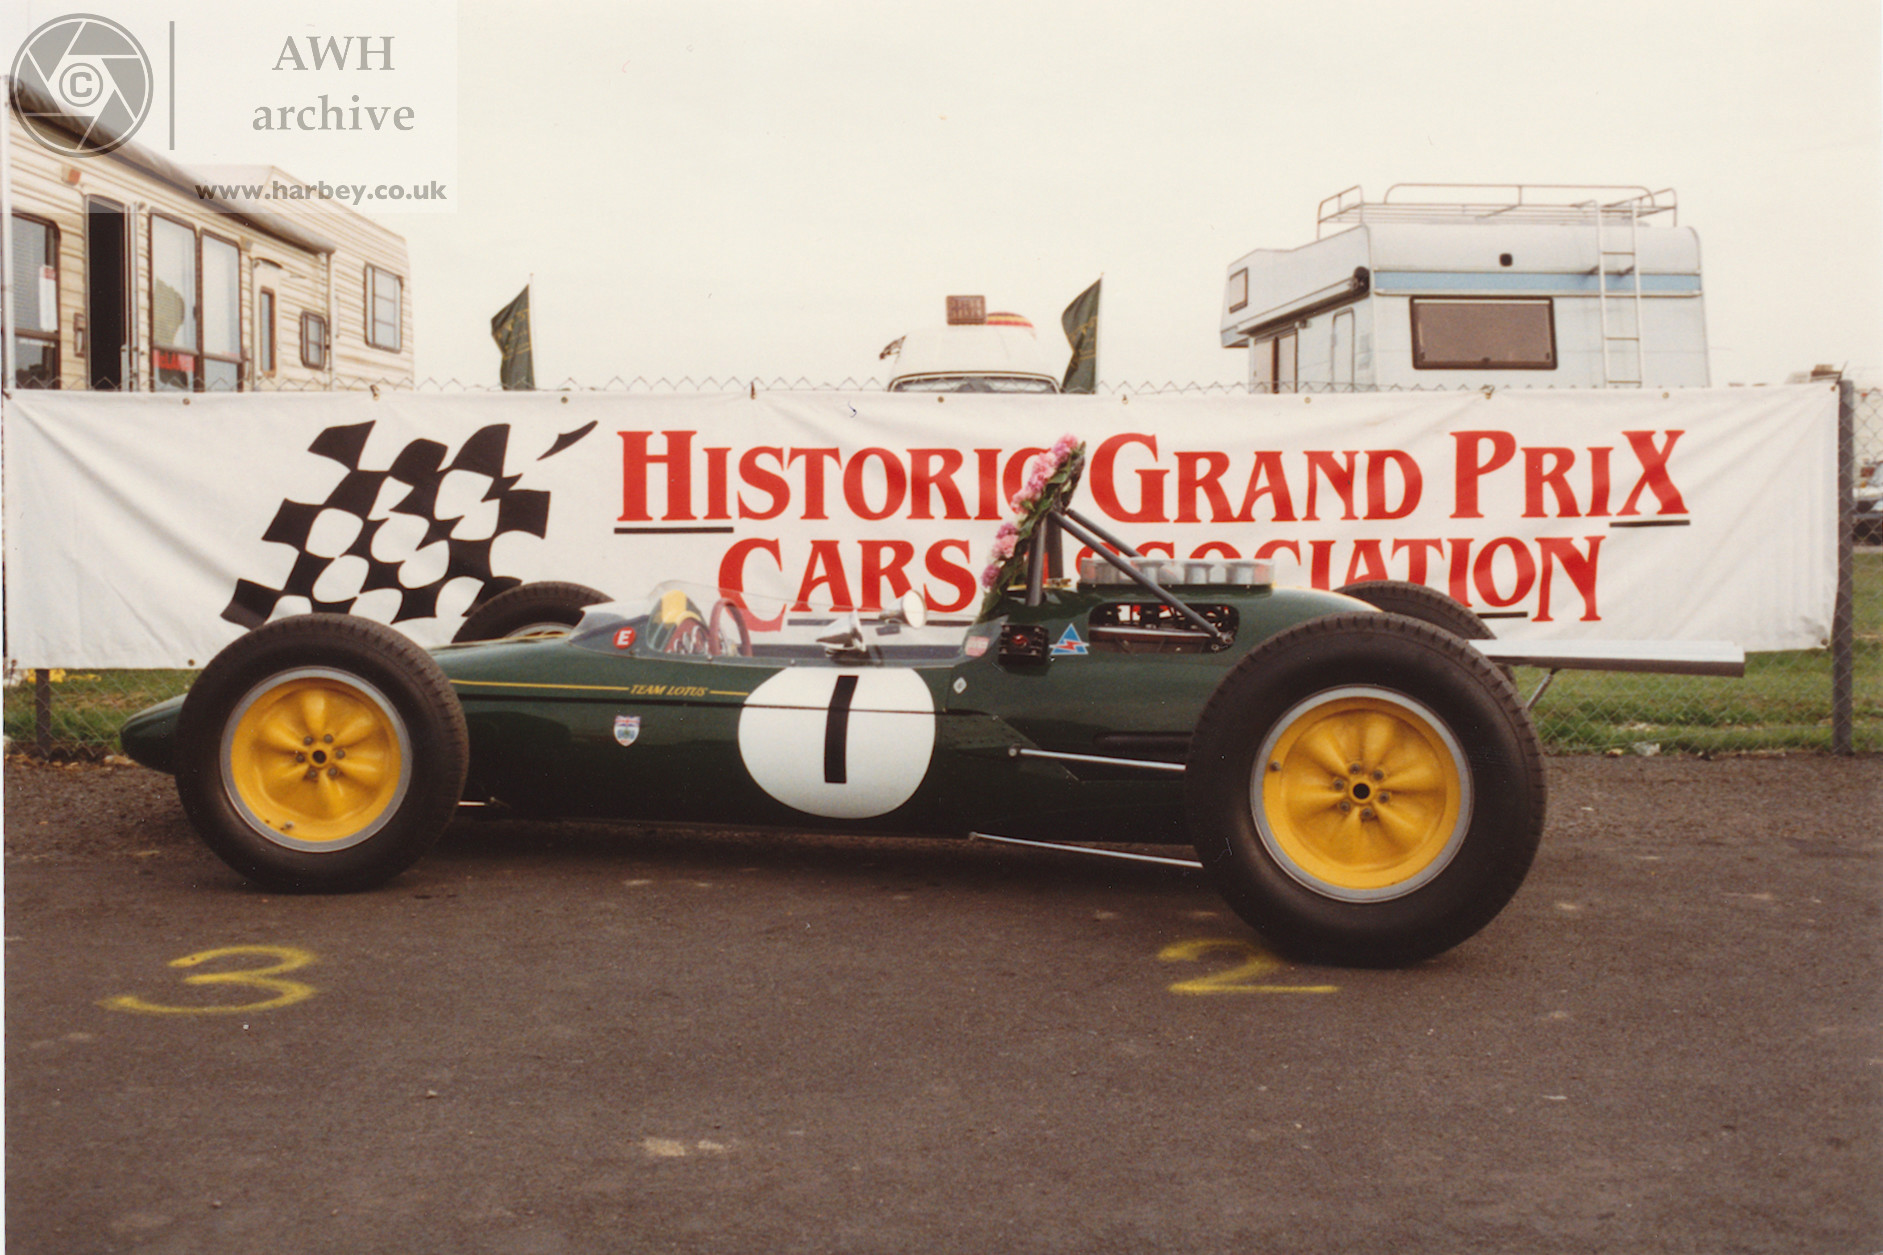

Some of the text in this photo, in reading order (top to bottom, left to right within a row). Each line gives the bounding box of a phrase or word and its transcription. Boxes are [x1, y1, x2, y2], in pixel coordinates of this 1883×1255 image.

[1088, 432, 1424, 524] GRAND
[1449, 429, 1689, 520] PRIX
[714, 537, 977, 633] CARS
[617, 630, 632, 646] E
[630, 684, 708, 697] TEAM LOTUS
[824, 675, 859, 784] 1
[101, 944, 318, 1014] 3
[1157, 938, 1340, 996] 2
